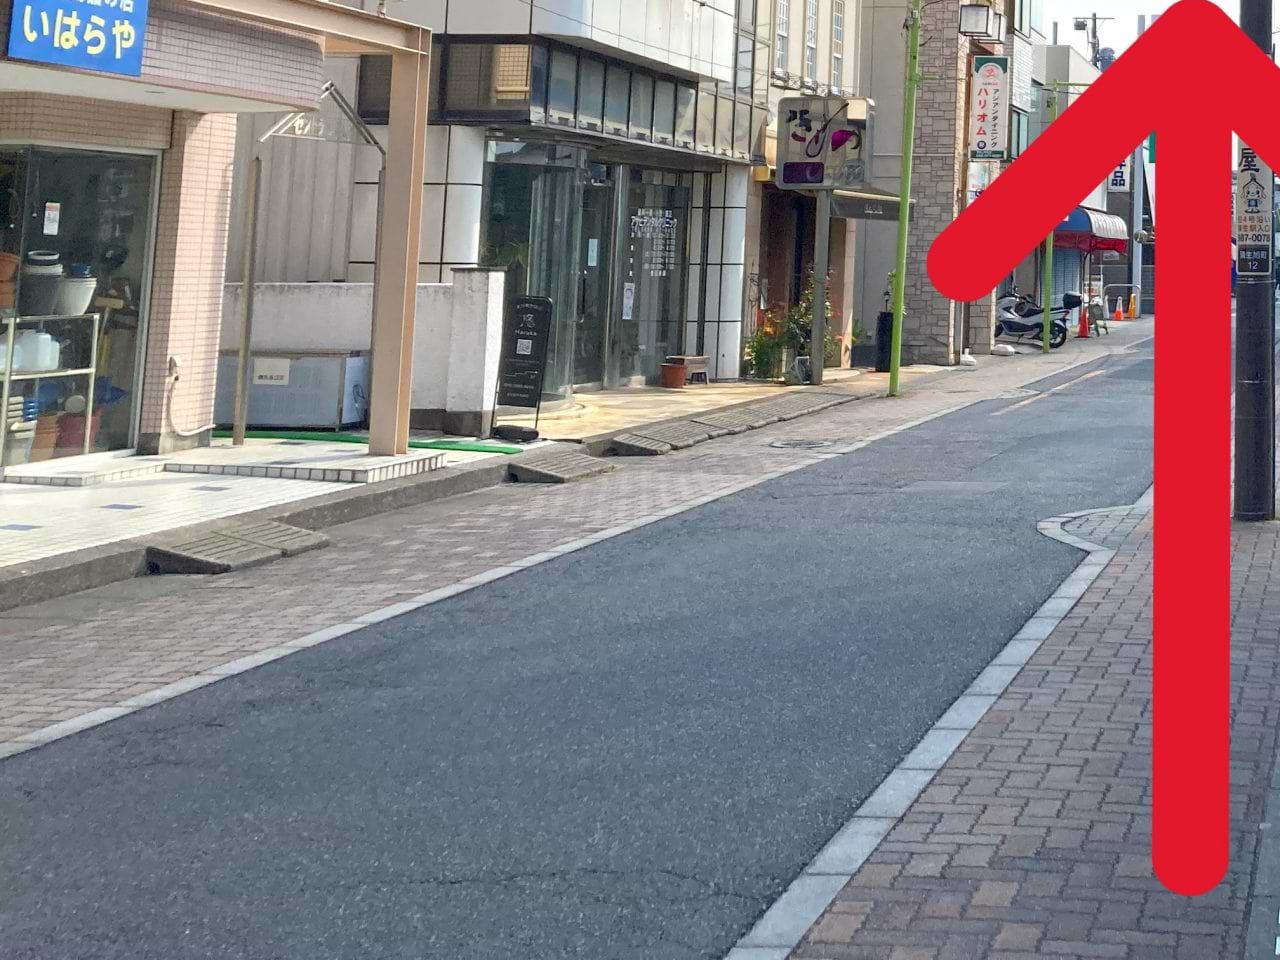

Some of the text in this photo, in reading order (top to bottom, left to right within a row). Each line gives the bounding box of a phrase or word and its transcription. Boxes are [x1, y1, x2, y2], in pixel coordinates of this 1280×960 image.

[23, 4, 136, 60] いはらや
[976, 88, 989, 136] ハリオム
[1239, 148, 1259, 172] 屋
[1248, 261, 1258, 270] 12
